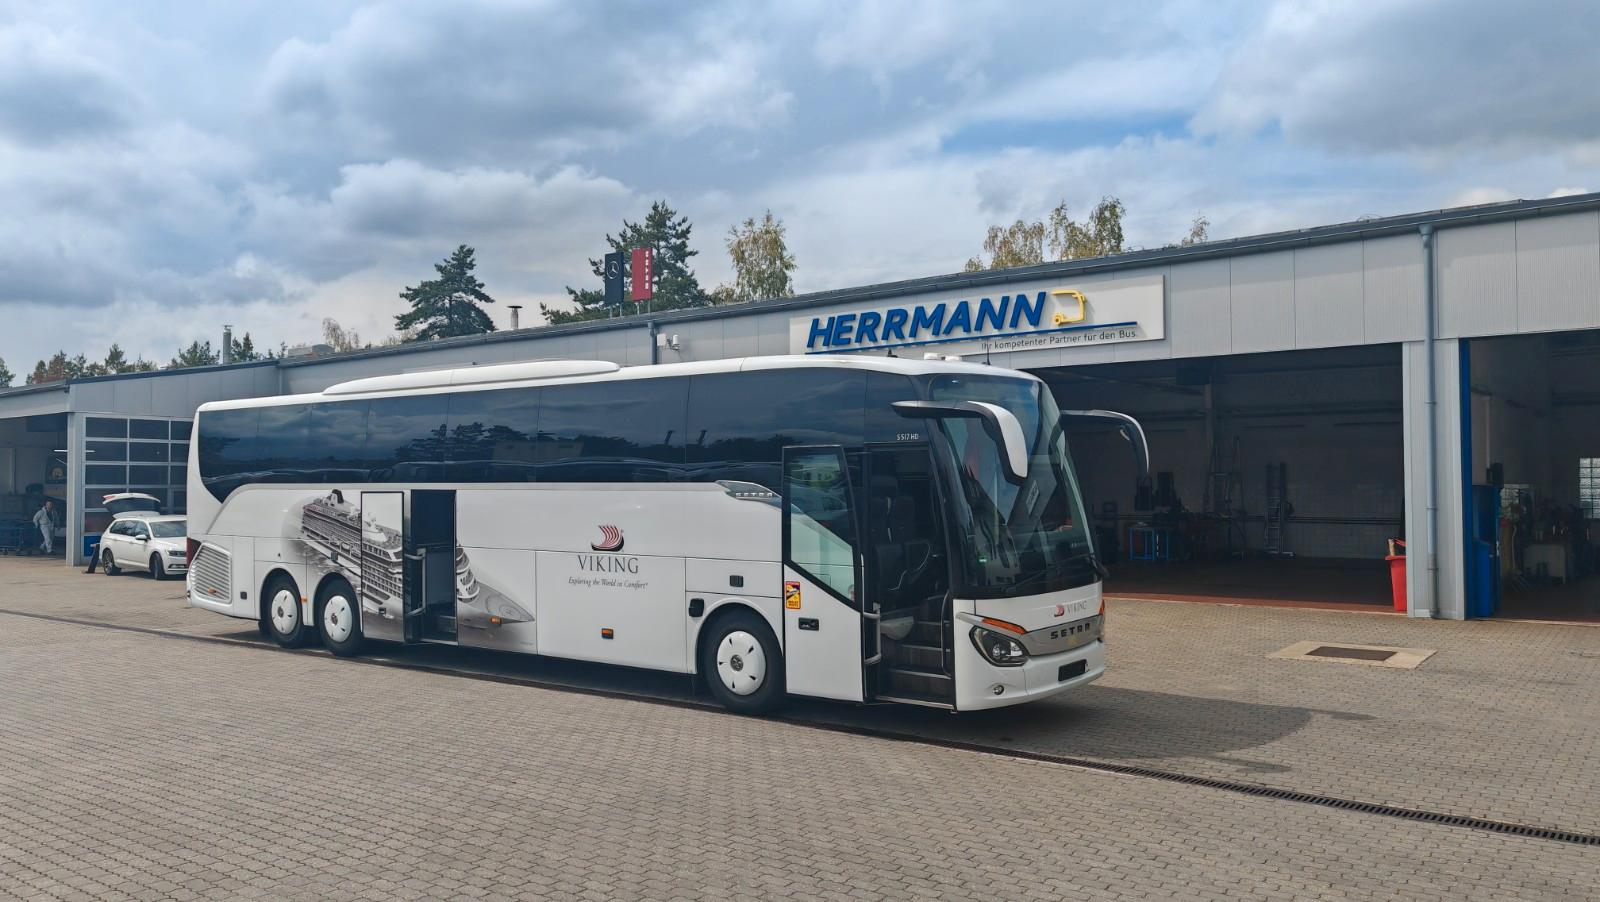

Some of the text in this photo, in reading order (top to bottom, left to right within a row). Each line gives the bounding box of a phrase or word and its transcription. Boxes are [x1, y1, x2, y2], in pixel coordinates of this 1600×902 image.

[806, 291, 1047, 348] HERRMANN
[994, 338, 1047, 350] kompetenter
[1050, 335, 1081, 345] Partner
[1099, 331, 1116, 340] den
[1119, 329, 1136, 339] Bus
[578, 554, 639, 574] VIKING
[1050, 623, 1090, 640] SETRA
